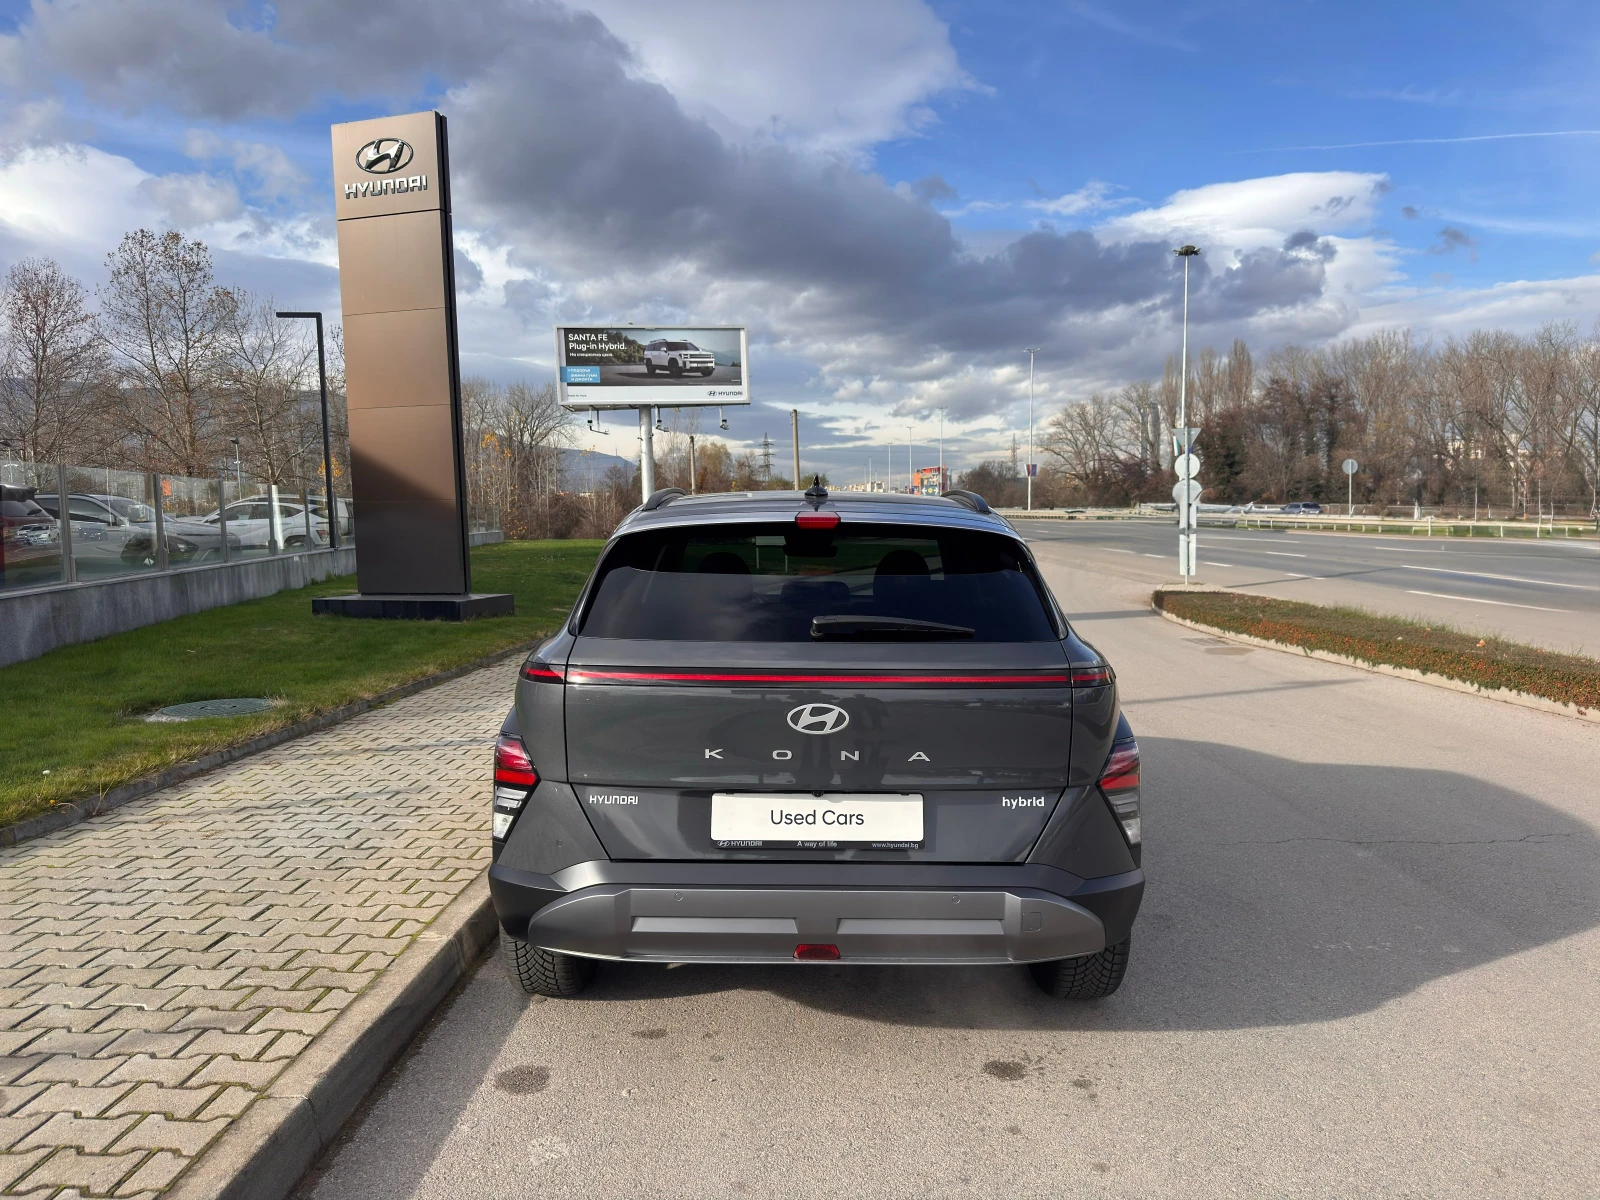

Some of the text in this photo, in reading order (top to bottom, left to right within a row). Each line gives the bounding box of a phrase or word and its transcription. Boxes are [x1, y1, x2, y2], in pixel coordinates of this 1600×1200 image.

[344, 174, 428, 199] HYUNDAI
[568, 333, 608, 341] SANTA FE
[569, 342, 627, 352] Plug-in Hybrid.
[704, 748, 931, 762] KONA
[589, 795, 639, 805] HYUNDAI
[1002, 796, 1045, 810] hybrid
[770, 809, 865, 825] Used Cars
